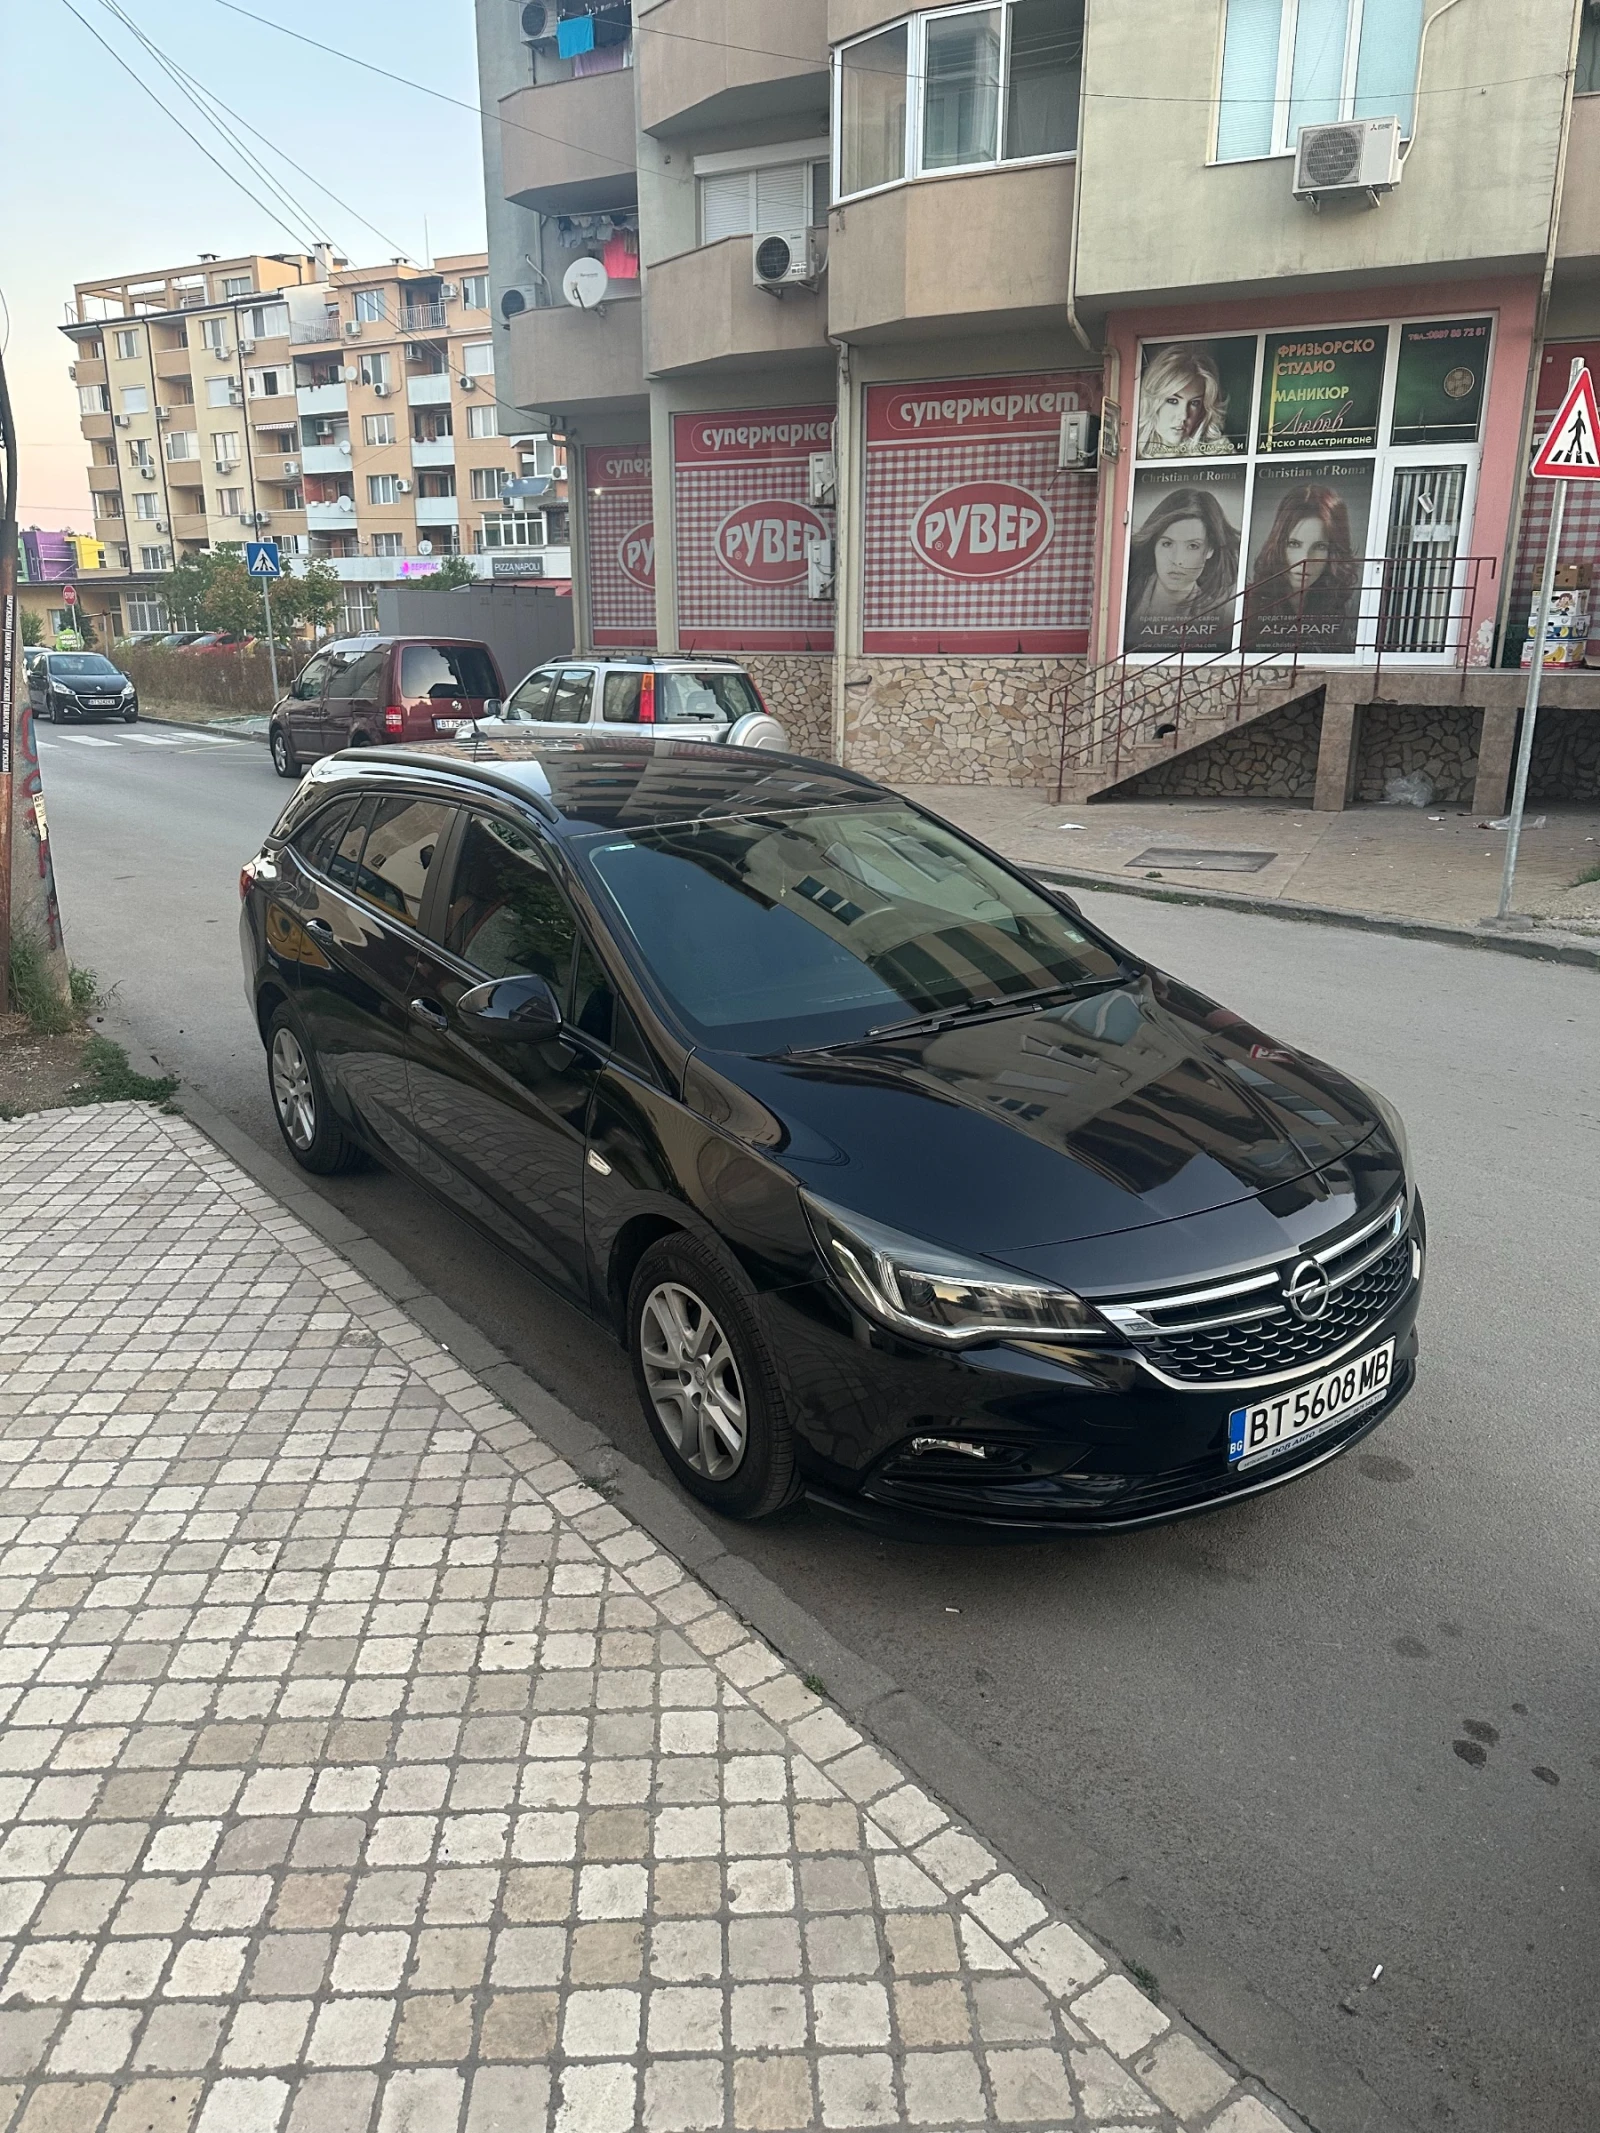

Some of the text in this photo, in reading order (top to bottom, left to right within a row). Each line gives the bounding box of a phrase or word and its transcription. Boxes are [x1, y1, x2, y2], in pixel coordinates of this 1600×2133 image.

[1277, 339, 1375, 358] ФРИЗЬОРСКО
[1276, 360, 1336, 376] СТУДИО
[1274, 386, 1350, 403] МАНИКЮР
[900, 391, 1079, 427] супермаркет
[1269, 400, 1354, 436] Любов
[702, 422, 832, 451] супермарке
[1298, 434, 1372, 449] подстригване
[1141, 470, 1237, 484] Christian of Roma
[1258, 465, 1366, 479] Christian of Roma
[924, 503, 1042, 559] РУВЕР
[494, 562, 541, 572] PIZZA NAPOLI
[64, 592, 75, 600] STOP
[1140, 624, 1218, 635] ALFAPARF
[1259, 623, 1341, 635] ALFAPARF
[1250, 1349, 1389, 1448] BT 5608 MB
[1230, 1440, 1243, 1455] BG
